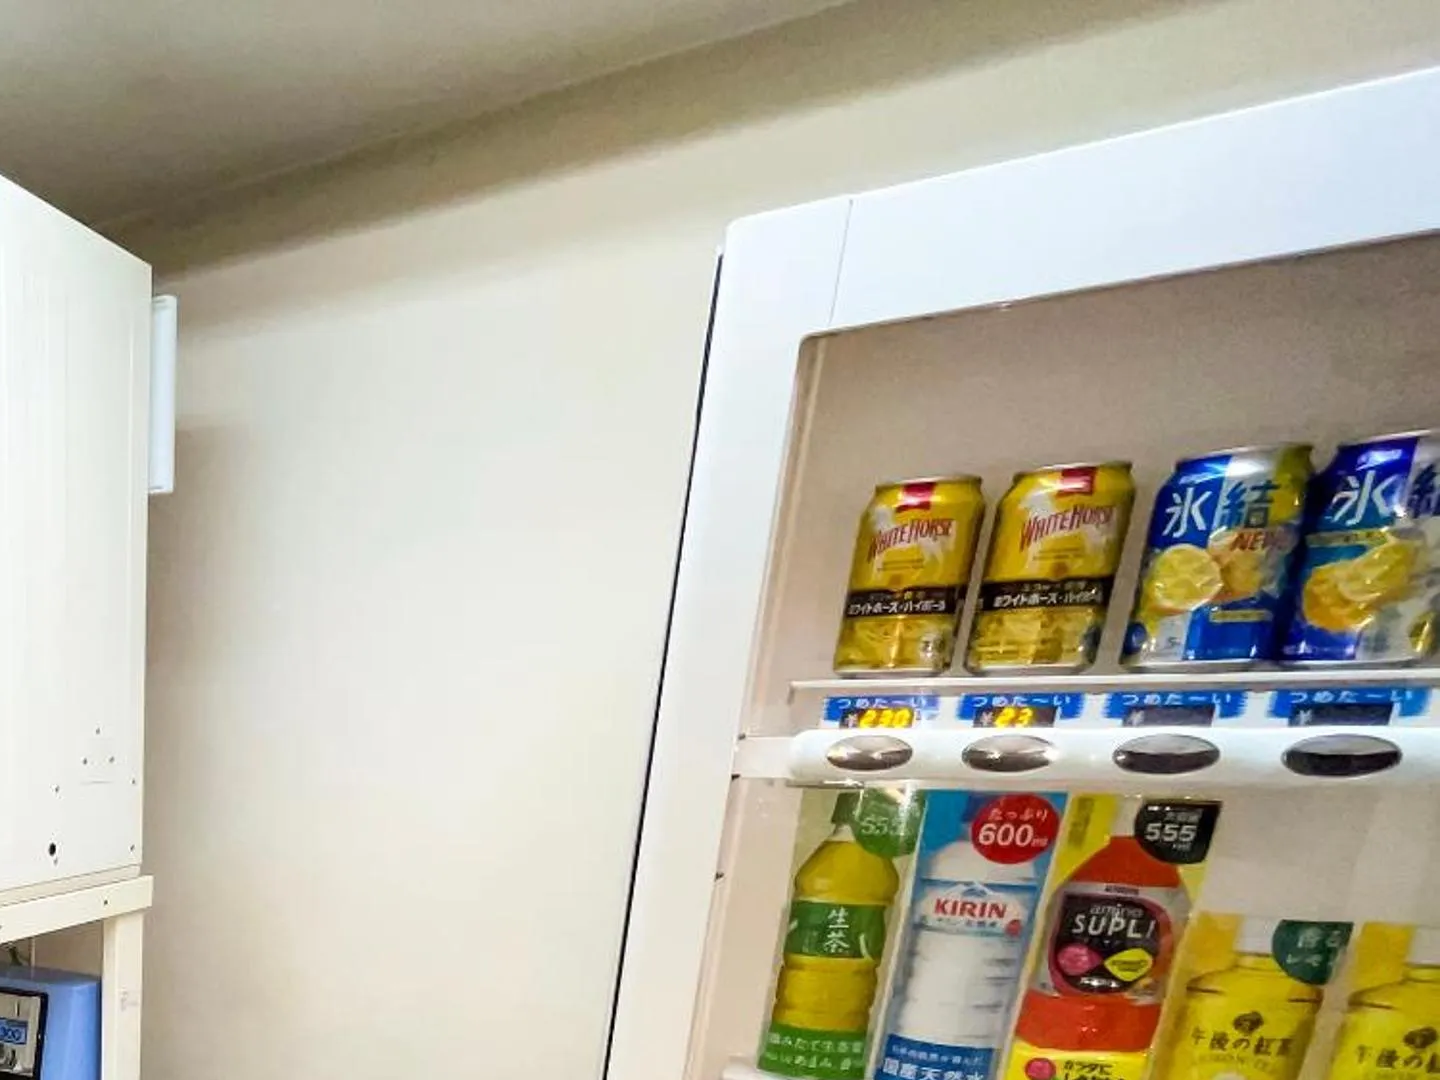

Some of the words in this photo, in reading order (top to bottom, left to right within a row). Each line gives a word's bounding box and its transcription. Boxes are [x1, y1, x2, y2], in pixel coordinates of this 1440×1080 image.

[1162, 479, 1280, 537] 氷結
[988, 807, 1049, 822] たっぷり
[1144, 822, 1197, 842] 555
[934, 898, 1007, 918] KIRIN
[823, 906, 850, 954] 生茶
[1071, 914, 1157, 939] SUPLI
